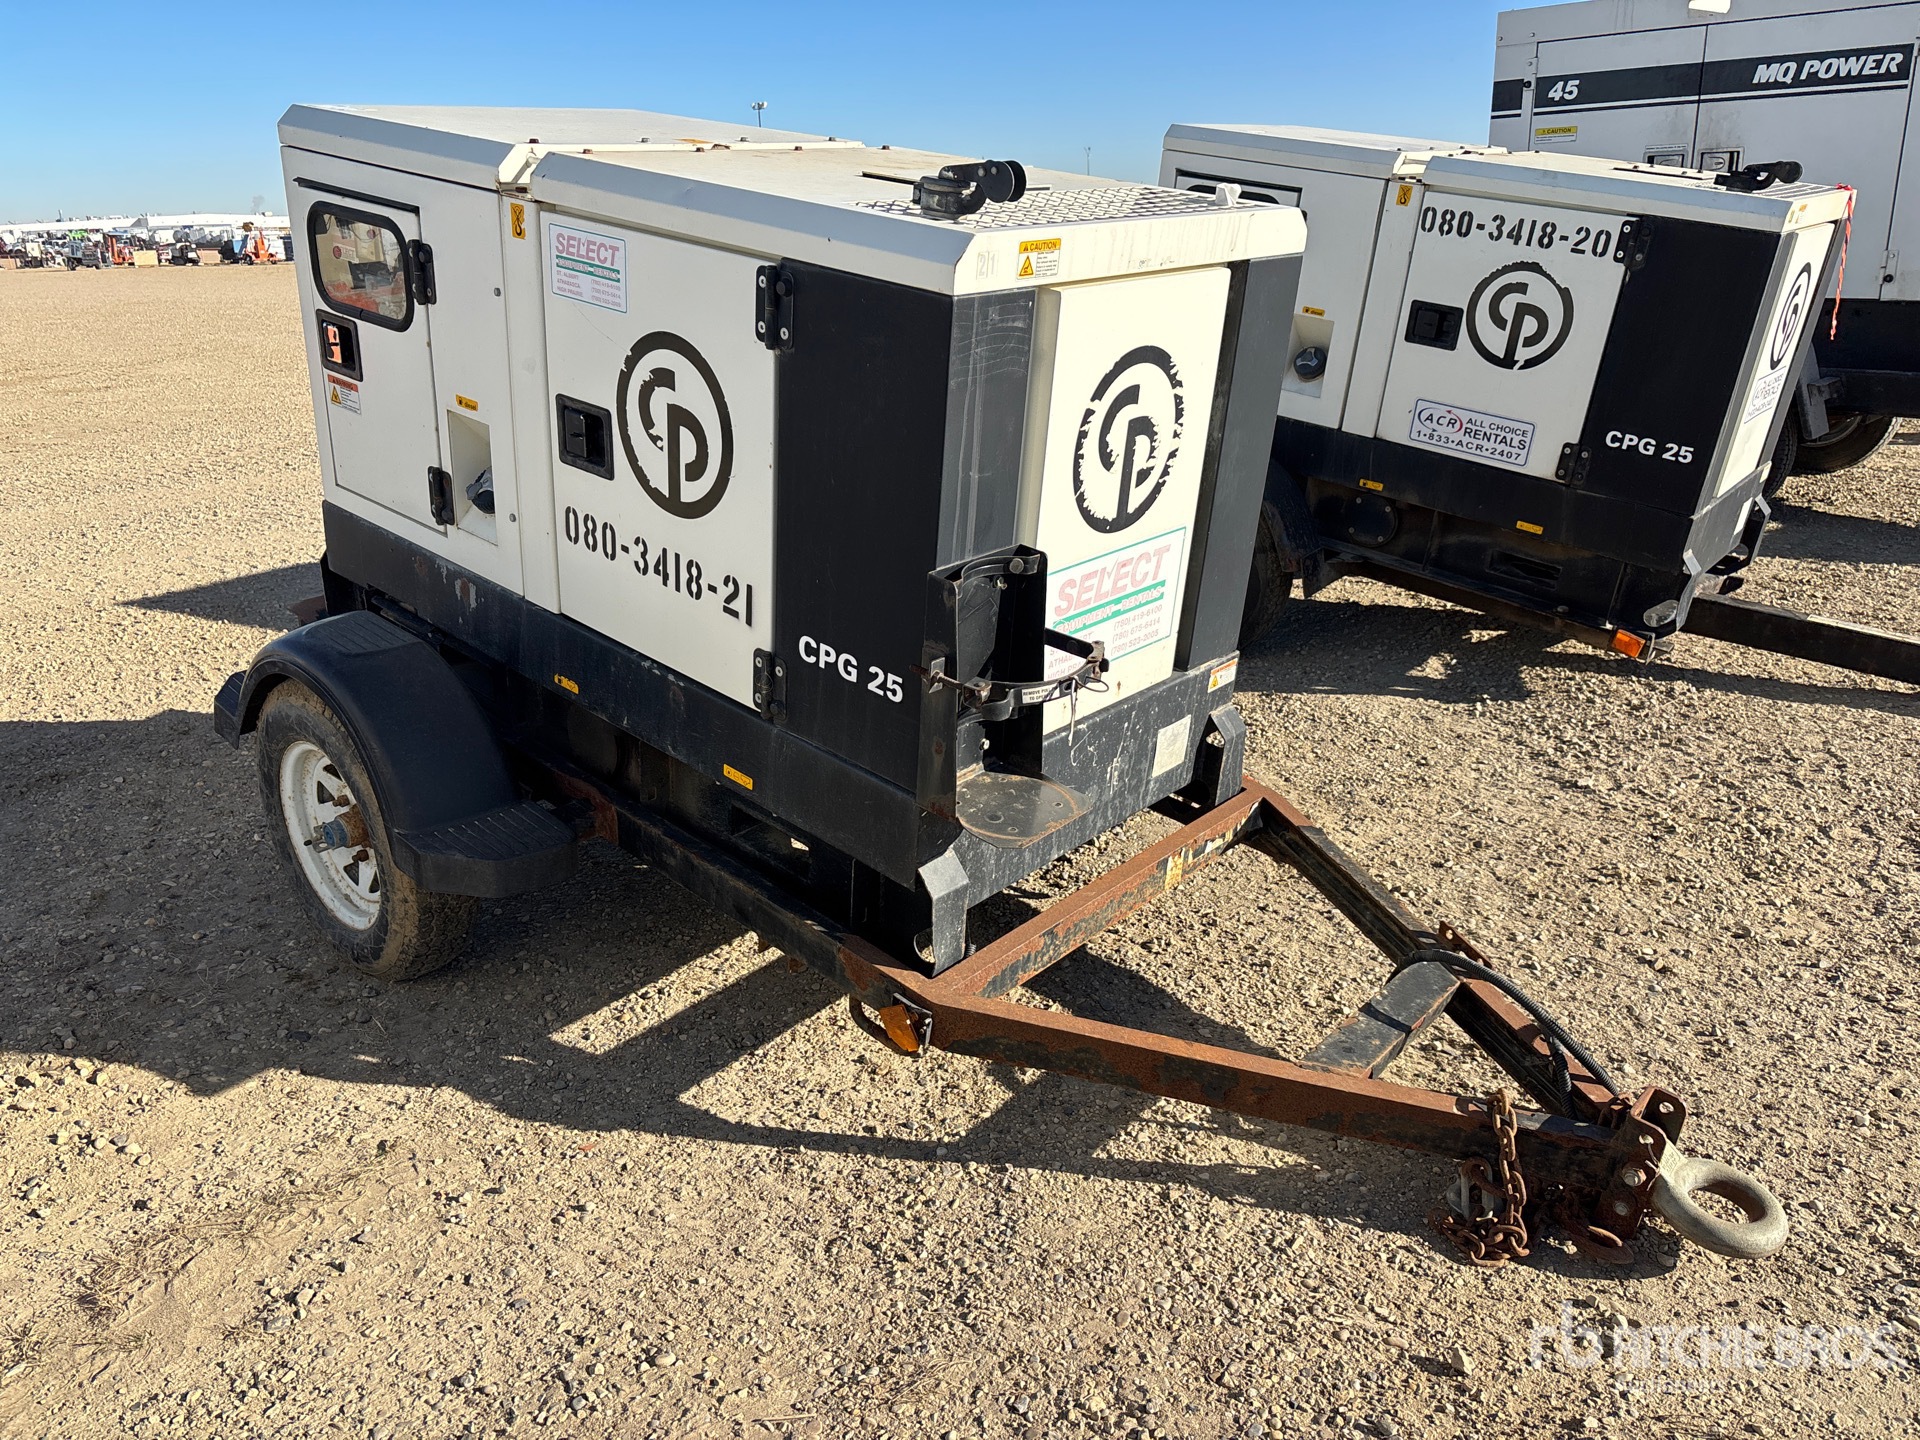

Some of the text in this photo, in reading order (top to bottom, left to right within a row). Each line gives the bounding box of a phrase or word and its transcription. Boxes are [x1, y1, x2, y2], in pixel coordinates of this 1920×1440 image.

[1752, 52, 1904, 84] MQ POWER
[1547, 79, 1580, 101] 45
[1546, 127, 1572, 135] CAUTION
[1029, 241, 1058, 252] CAUTION
[1420, 206, 1612, 258] 080-3418-20
[555, 232, 620, 267] SELECT
[1423, 413, 1530, 438] ACR ALL CHOICE
[1463, 427, 1527, 451] RENTALS
[1605, 430, 1695, 464] CPG 25
[564, 505, 753, 628] 080-3418-21
[1054, 543, 1171, 618] SELECT
[1057, 586, 1162, 633] EQUIPMENT RENTALS
[798, 635, 904, 703] CPG 25
